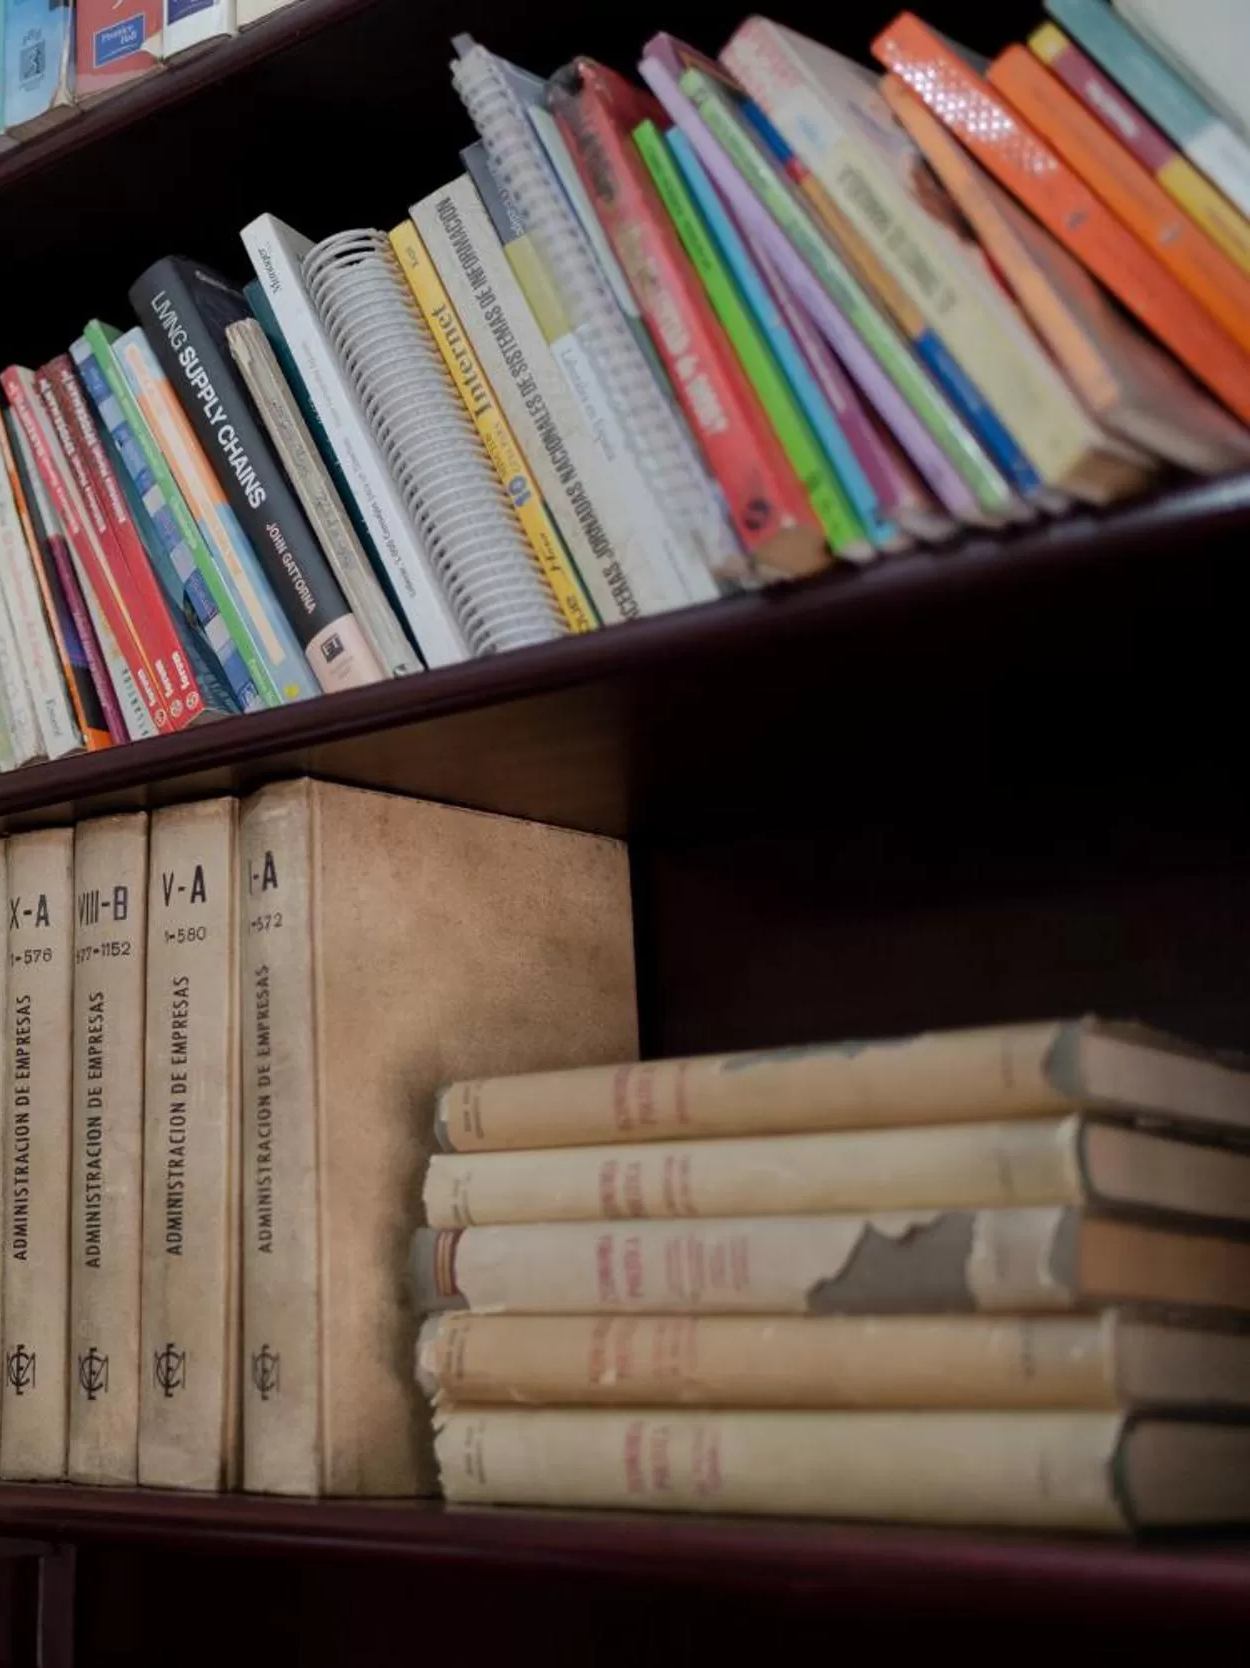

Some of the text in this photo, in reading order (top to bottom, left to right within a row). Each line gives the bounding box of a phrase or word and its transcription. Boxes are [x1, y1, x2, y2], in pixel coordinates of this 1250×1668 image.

[435, 196, 486, 290] INFORMACION
[471, 283, 497, 311] DE
[484, 301, 530, 379] SISTEMAS
[151, 290, 267, 510] LIVING SUPPLY CHAINS
[431, 306, 492, 420] Internet
[516, 374, 536, 398] DE
[526, 395, 577, 484] NACIONALES
[508, 475, 532, 508] 10
[565, 480, 617, 565] JORNADAS
[266, 522, 317, 615] JOHN GATTORNA
[603, 557, 641, 620] CERAS
[10, 894, 49, 931] X-A
[163, 864, 206, 907] V-A
[13, 994, 31, 1261] ADMINISTRACION DE EMPRESAS
[85, 991, 105, 1270] ADMINISTRACION DE EMPRESAS
[166, 975, 190, 1257] ADMINISTRACION DE EMPRESAS
[256, 963, 272, 1254] ADMINISTRACION DE EMPRESAS
